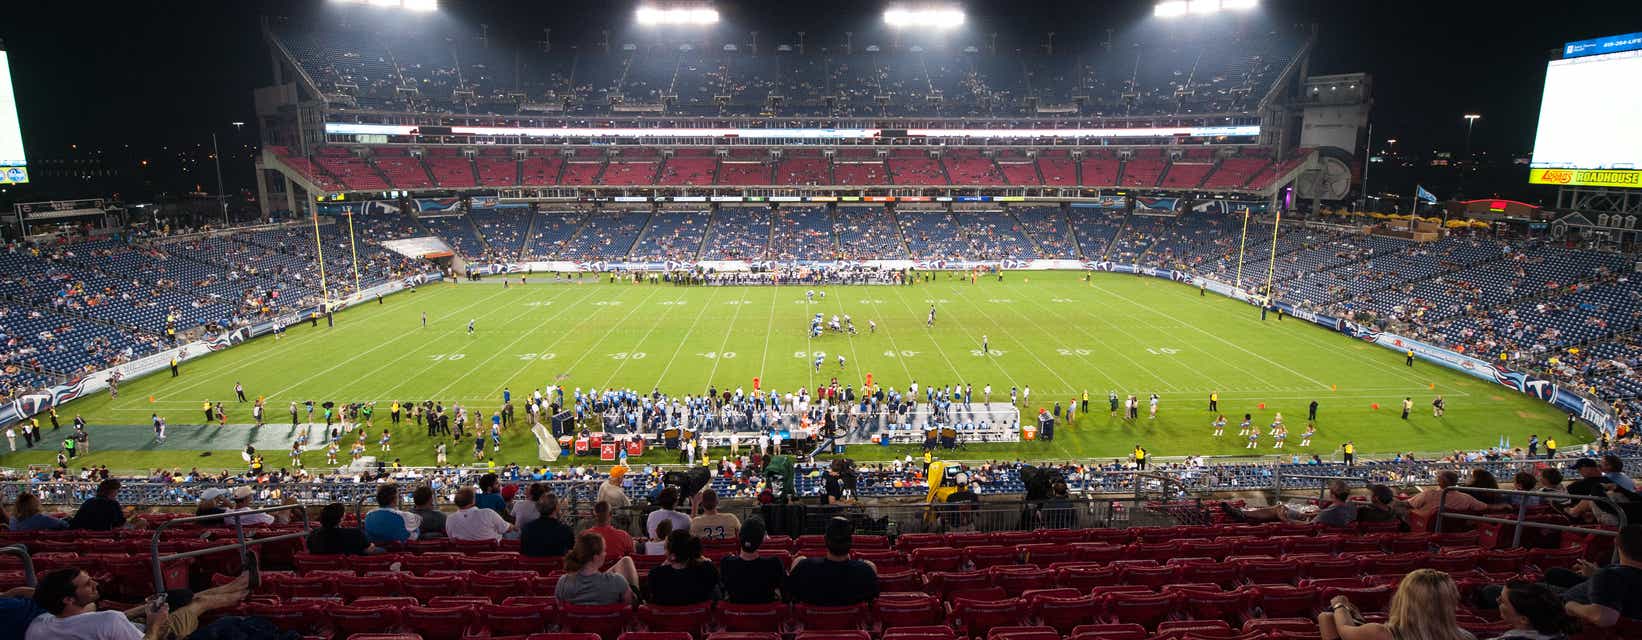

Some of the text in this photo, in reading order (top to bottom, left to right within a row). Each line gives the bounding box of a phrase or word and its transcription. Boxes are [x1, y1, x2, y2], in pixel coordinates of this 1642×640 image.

[1576, 171, 1640, 184] ROADHOUSE
[1292, 305, 1318, 323] TITANS
[518, 352, 557, 361] 20
[613, 352, 647, 361] 30
[705, 351, 737, 360] 40
[794, 351, 827, 360] 50
[1580, 397, 1610, 434] TITANS
